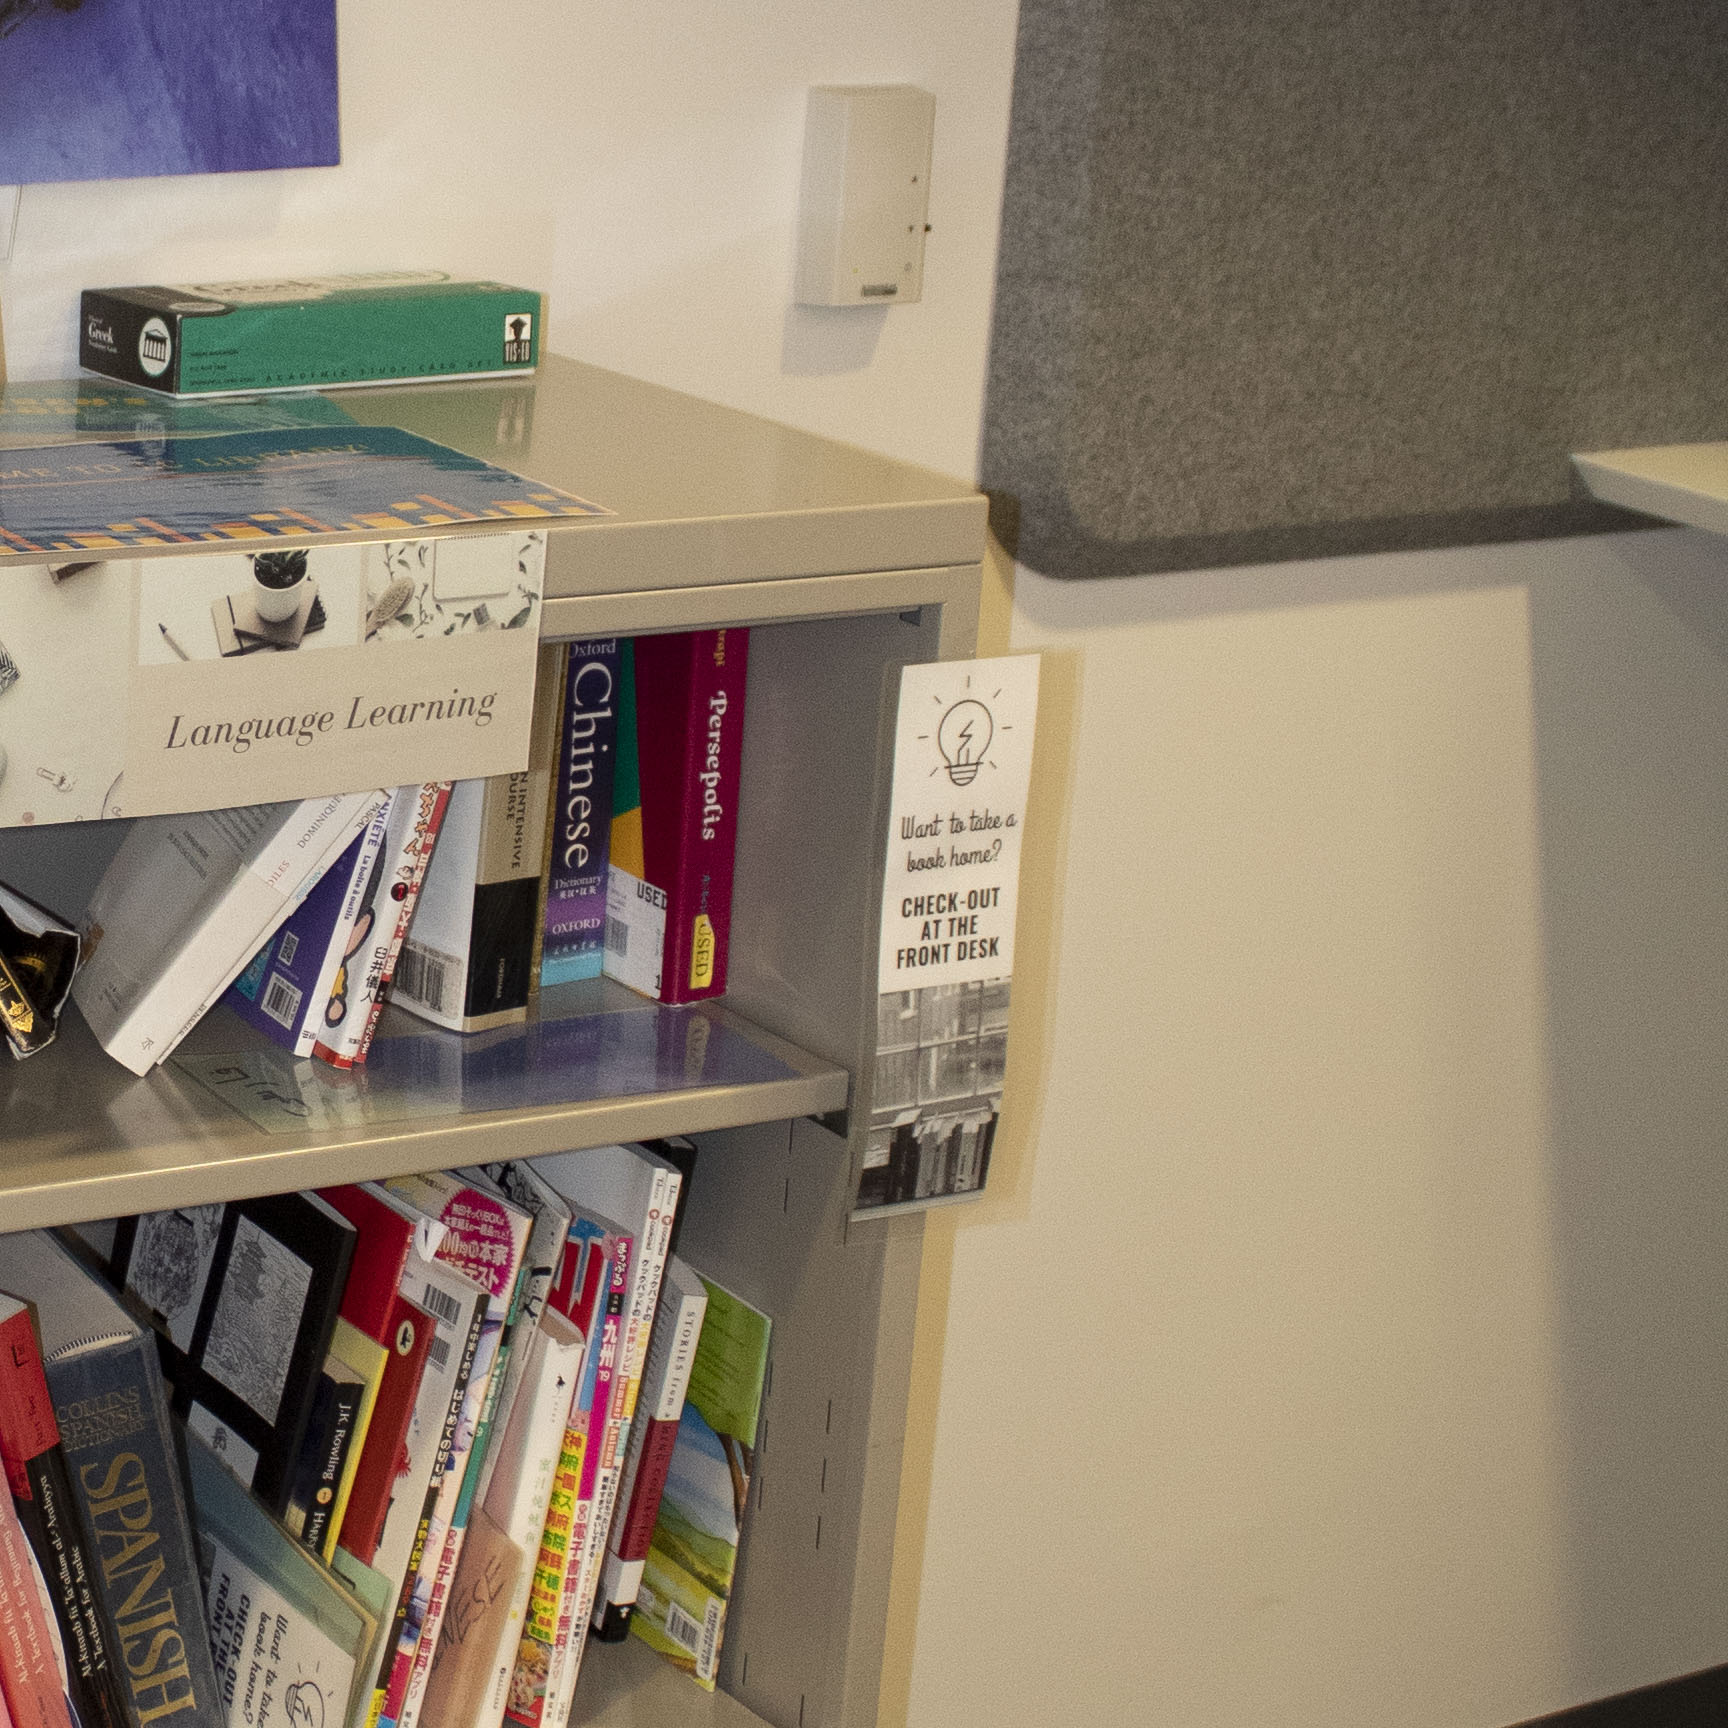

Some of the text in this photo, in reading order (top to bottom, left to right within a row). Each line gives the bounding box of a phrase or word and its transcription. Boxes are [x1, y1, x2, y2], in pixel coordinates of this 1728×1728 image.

[164, 686, 500, 753] Language Learning
[553, 659, 617, 871] Chinese
[695, 690, 727, 840] Persepolis
[296, 793, 342, 851] DOMINIQUE
[511, 787, 527, 870] INTENSIVE
[900, 807, 1017, 840] Want to take a
[293, 800, 381, 903] LAROUSSE PASCAL
[906, 837, 1003, 872] book home?
[342, 895, 358, 921] outils
[552, 871, 603, 893] Dictionary
[901, 886, 1001, 918] CHECK-OUT
[550, 916, 601, 935] OXFORD
[693, 921, 712, 978] USED
[896, 936, 1000, 969] FRONT DESK
[920, 914, 978, 941] AT THE
[598, 1241, 629, 1367] まっぷる 九州
[665, 1310, 697, 1407] STORIES from
[54, 1387, 141, 1421] COLLINS
[58, 1403, 144, 1439] SPANISH
[322, 1402, 351, 1481] J.K. Rowling
[13, 1590, 28, 1606] for
[66, 1544, 107, 1658] Textbook for Arabic
[210, 1572, 230, 1638] FRONT
[3, 1625, 32, 1683] Al-Kitaab
[17, 1609, 44, 1663] Textbook
[67, 1621, 96, 1678] Al-Kitaab
[214, 1607, 235, 1677] AT THE
[222, 1593, 251, 1708] CHECK-OUT
[262, 1613, 295, 1664] Want
[232, 1611, 278, 1724] book home?
